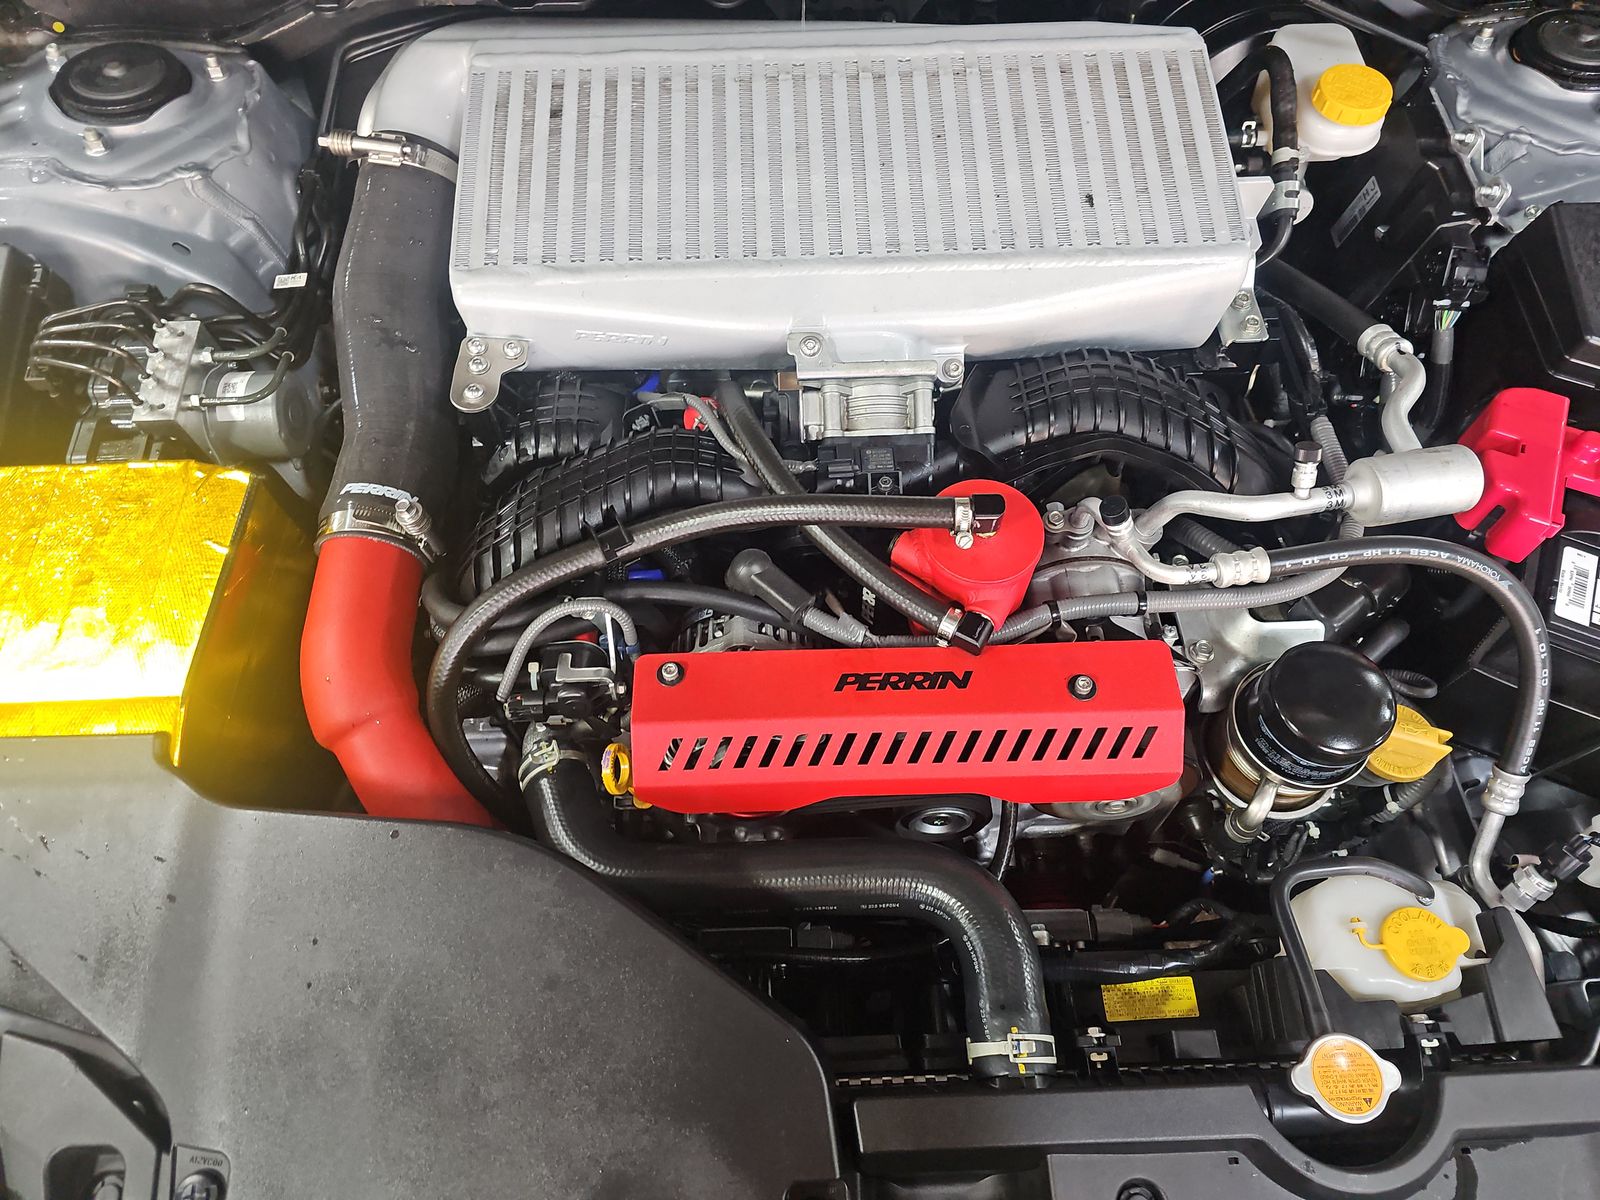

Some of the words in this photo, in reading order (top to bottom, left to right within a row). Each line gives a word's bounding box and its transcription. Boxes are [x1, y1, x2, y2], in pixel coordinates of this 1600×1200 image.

[339, 483, 419, 503] PERRIN
[1302, 557, 1320, 565] 10
[1329, 553, 1348, 561] CD
[1456, 555, 1501, 581] YOKOHAMA
[1539, 643, 1547, 659] 10
[834, 670, 974, 692] PERRIN
[1541, 668, 1549, 686] CD
[1537, 699, 1545, 715] HP
[1533, 721, 1541, 733] 11
